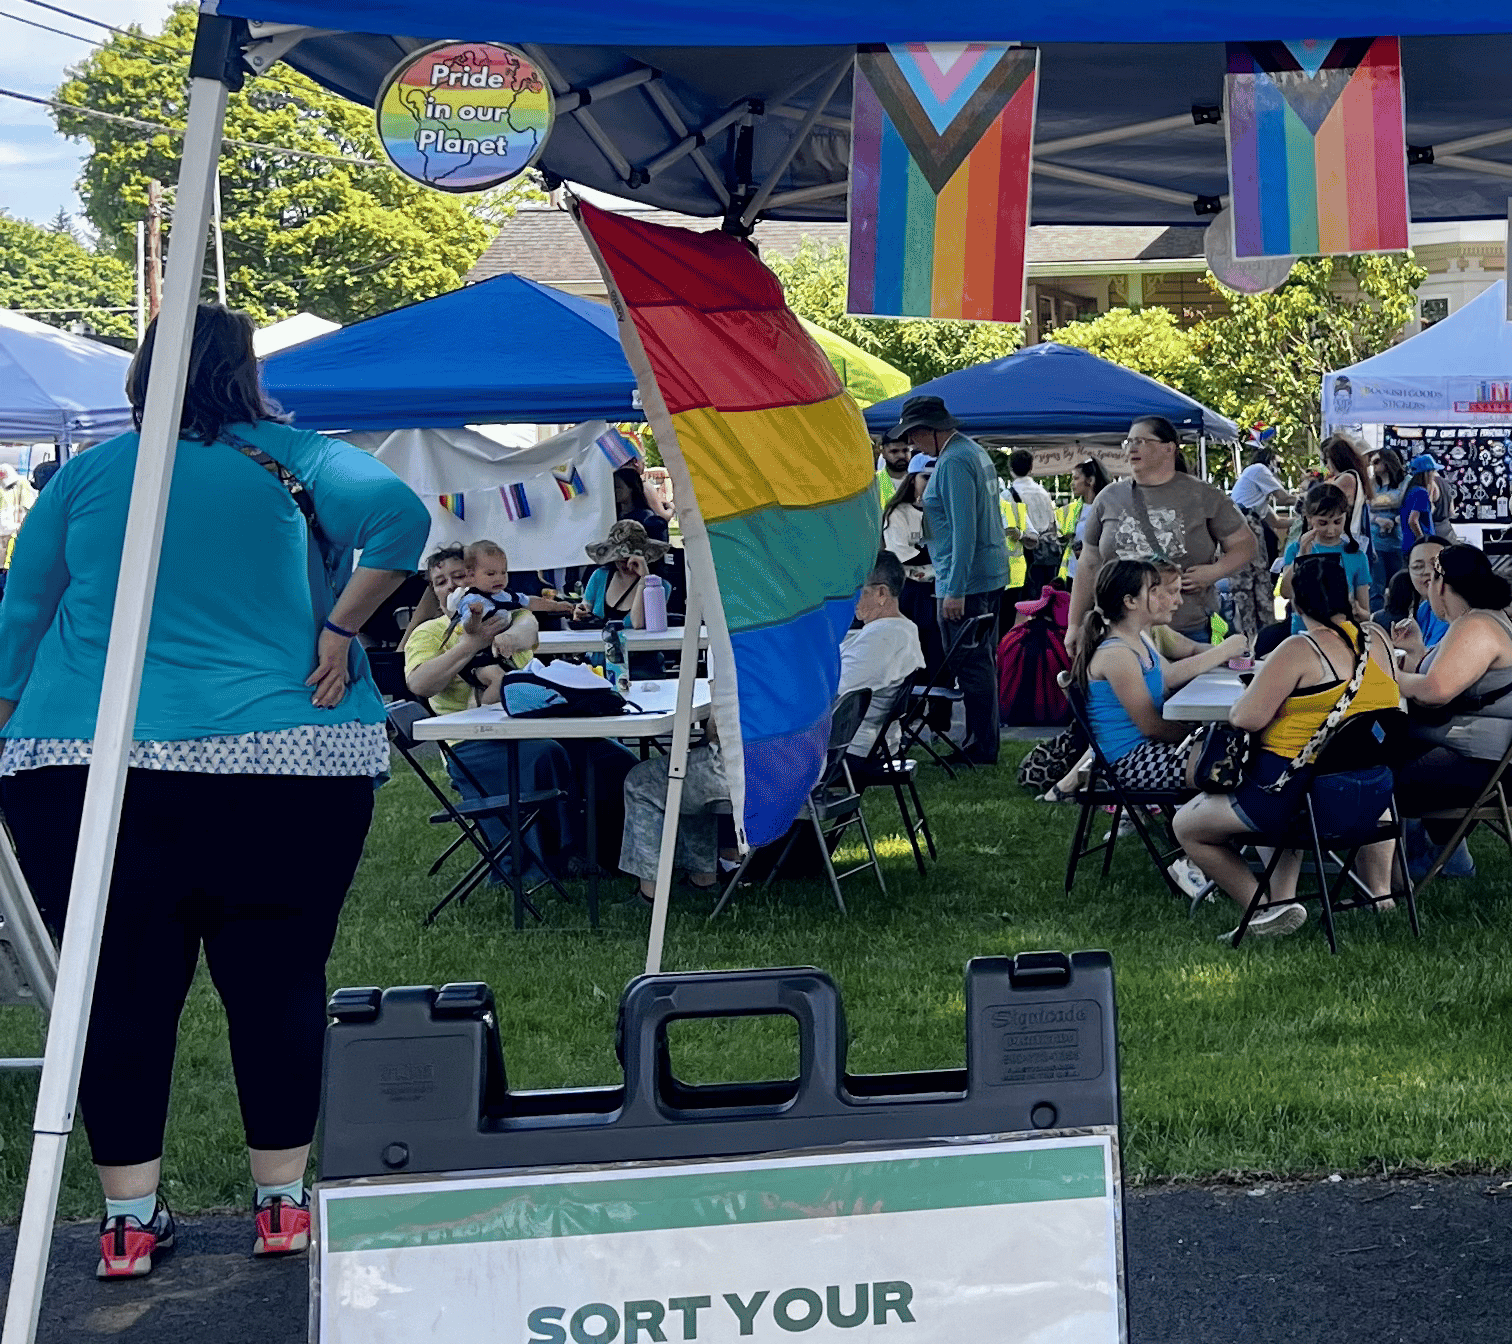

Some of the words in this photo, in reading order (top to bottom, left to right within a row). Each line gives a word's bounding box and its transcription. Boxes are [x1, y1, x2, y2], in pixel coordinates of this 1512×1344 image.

[430, 63, 505, 89] Pride
[425, 96, 452, 119] in
[458, 104, 509, 122] our
[418, 129, 508, 156] Planet
[1408, 388, 1443, 399] GOODS
[722, 1280, 916, 1336] YOUR
